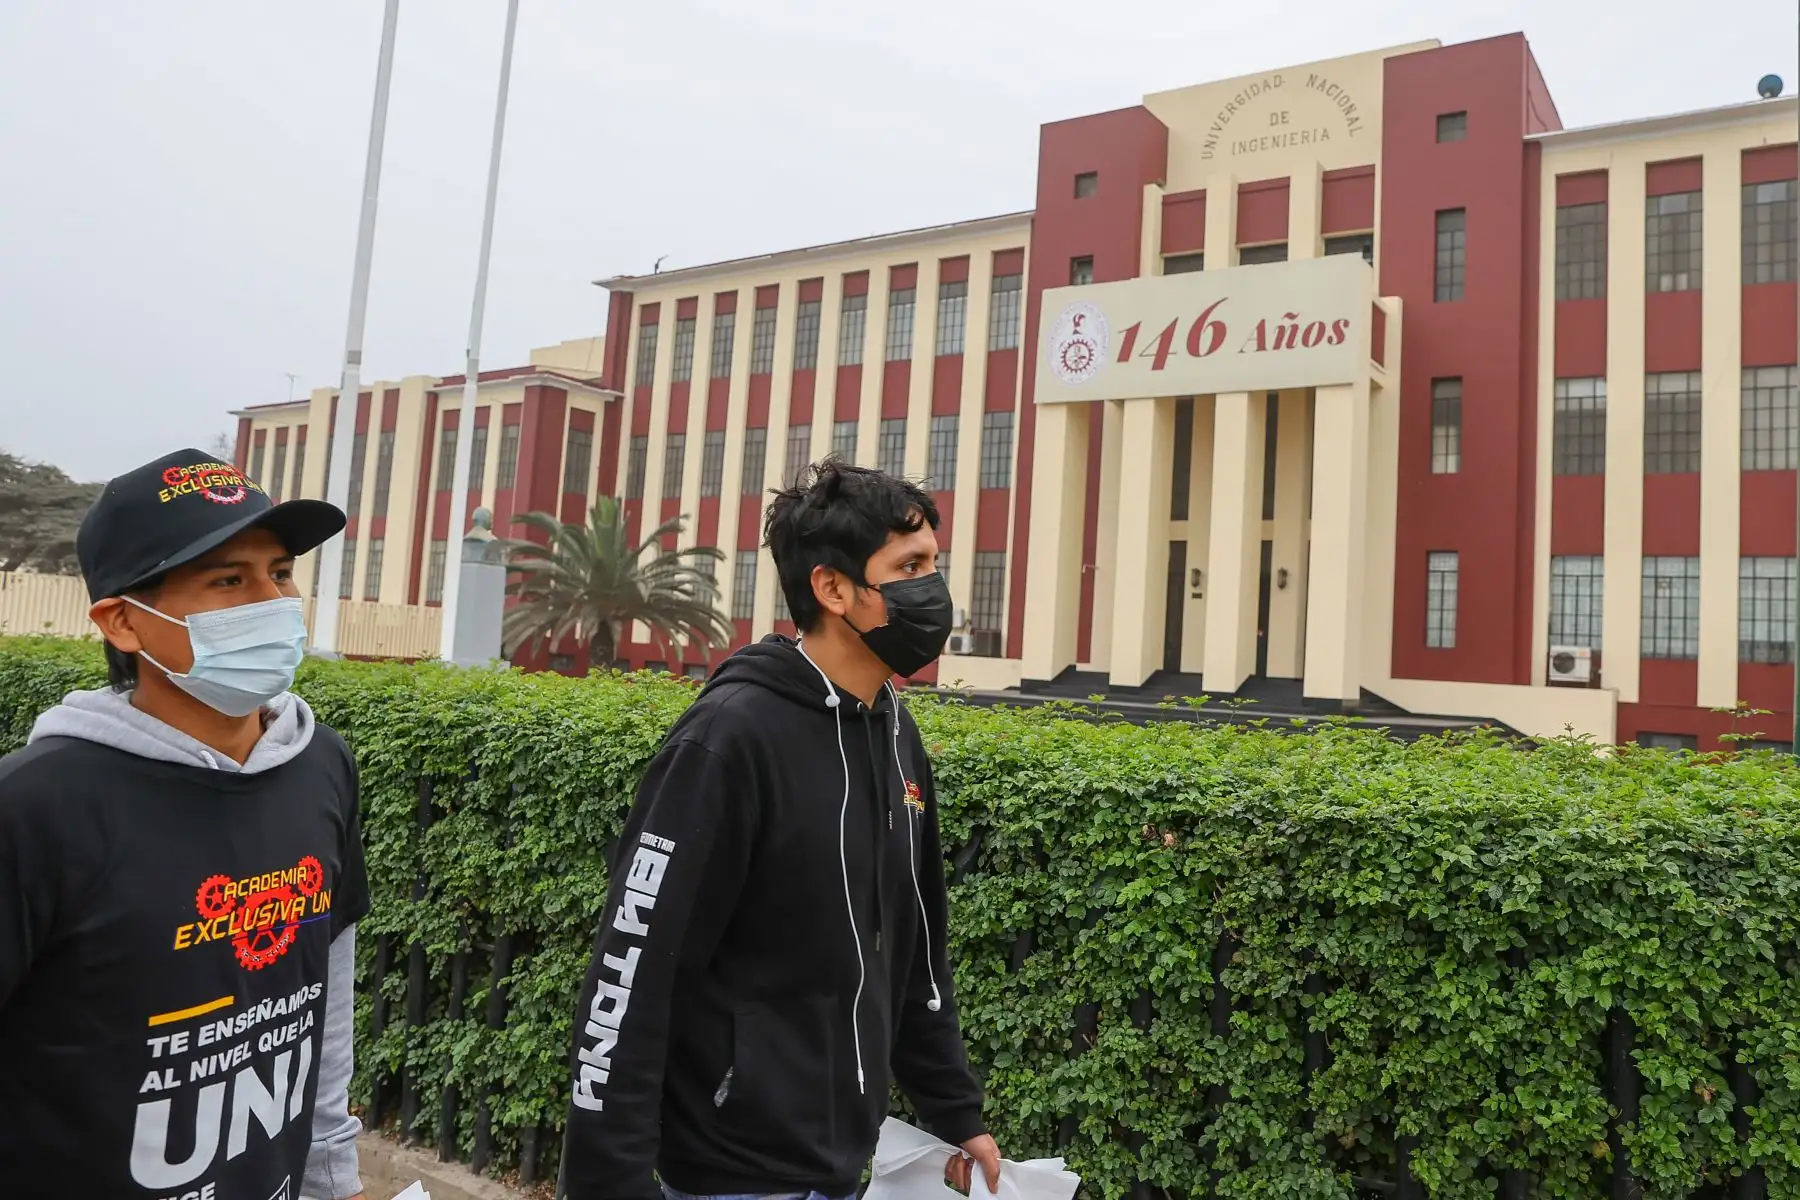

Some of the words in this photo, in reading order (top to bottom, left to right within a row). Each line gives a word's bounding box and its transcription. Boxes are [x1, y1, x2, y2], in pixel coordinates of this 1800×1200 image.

[1201, 75, 1283, 160] UNIVERSIDAD
[1306, 73, 1363, 137] NACIONAL
[1232, 128, 1331, 155] INGENIERIA
[1270, 111, 1289, 126] DE
[1116, 297, 1228, 370] 146
[1238, 312, 1350, 353] Años
[158, 474, 243, 503] EXCLUSIVA
[179, 462, 236, 477] ACADEMIA
[223, 866, 308, 902] ACADEMIA
[613, 847, 670, 936] BY
[173, 896, 306, 950] EXCLUSIVA
[139, 1068, 181, 1094] AL
[189, 1041, 252, 1082] NIVEL
[258, 1021, 298, 1052] QUE
[299, 1010, 314, 1035] LA
[147, 1031, 190, 1058] TE
[197, 982, 322, 1047] ENSEÑAMOS
[572, 946, 642, 1112] TONY
[129, 1036, 312, 1190] UNI
